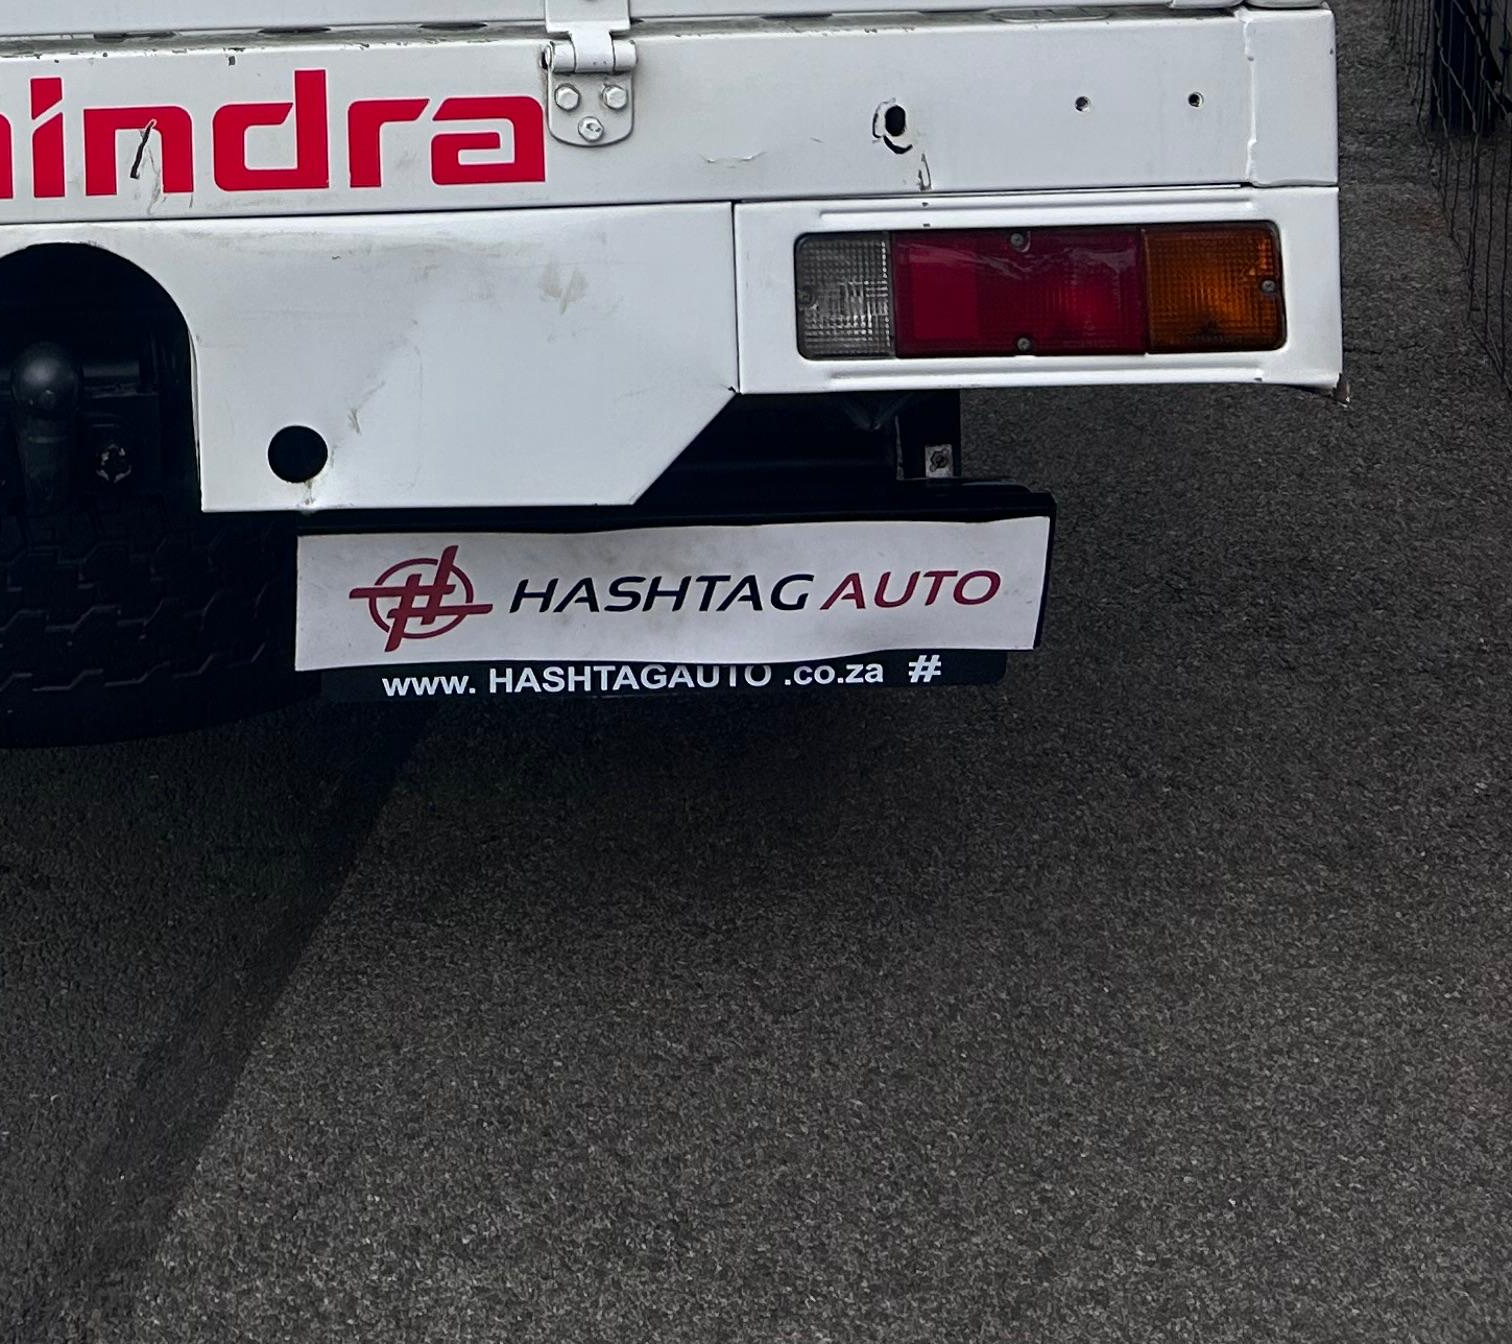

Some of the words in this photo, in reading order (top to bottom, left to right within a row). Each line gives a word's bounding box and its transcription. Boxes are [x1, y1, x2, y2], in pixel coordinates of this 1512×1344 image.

[508, 573, 815, 613] HASHTAG
[820, 570, 1002, 611] AUTO
[381, 675, 477, 697] www.
[488, 664, 773, 694] HASHTAGAUTO
